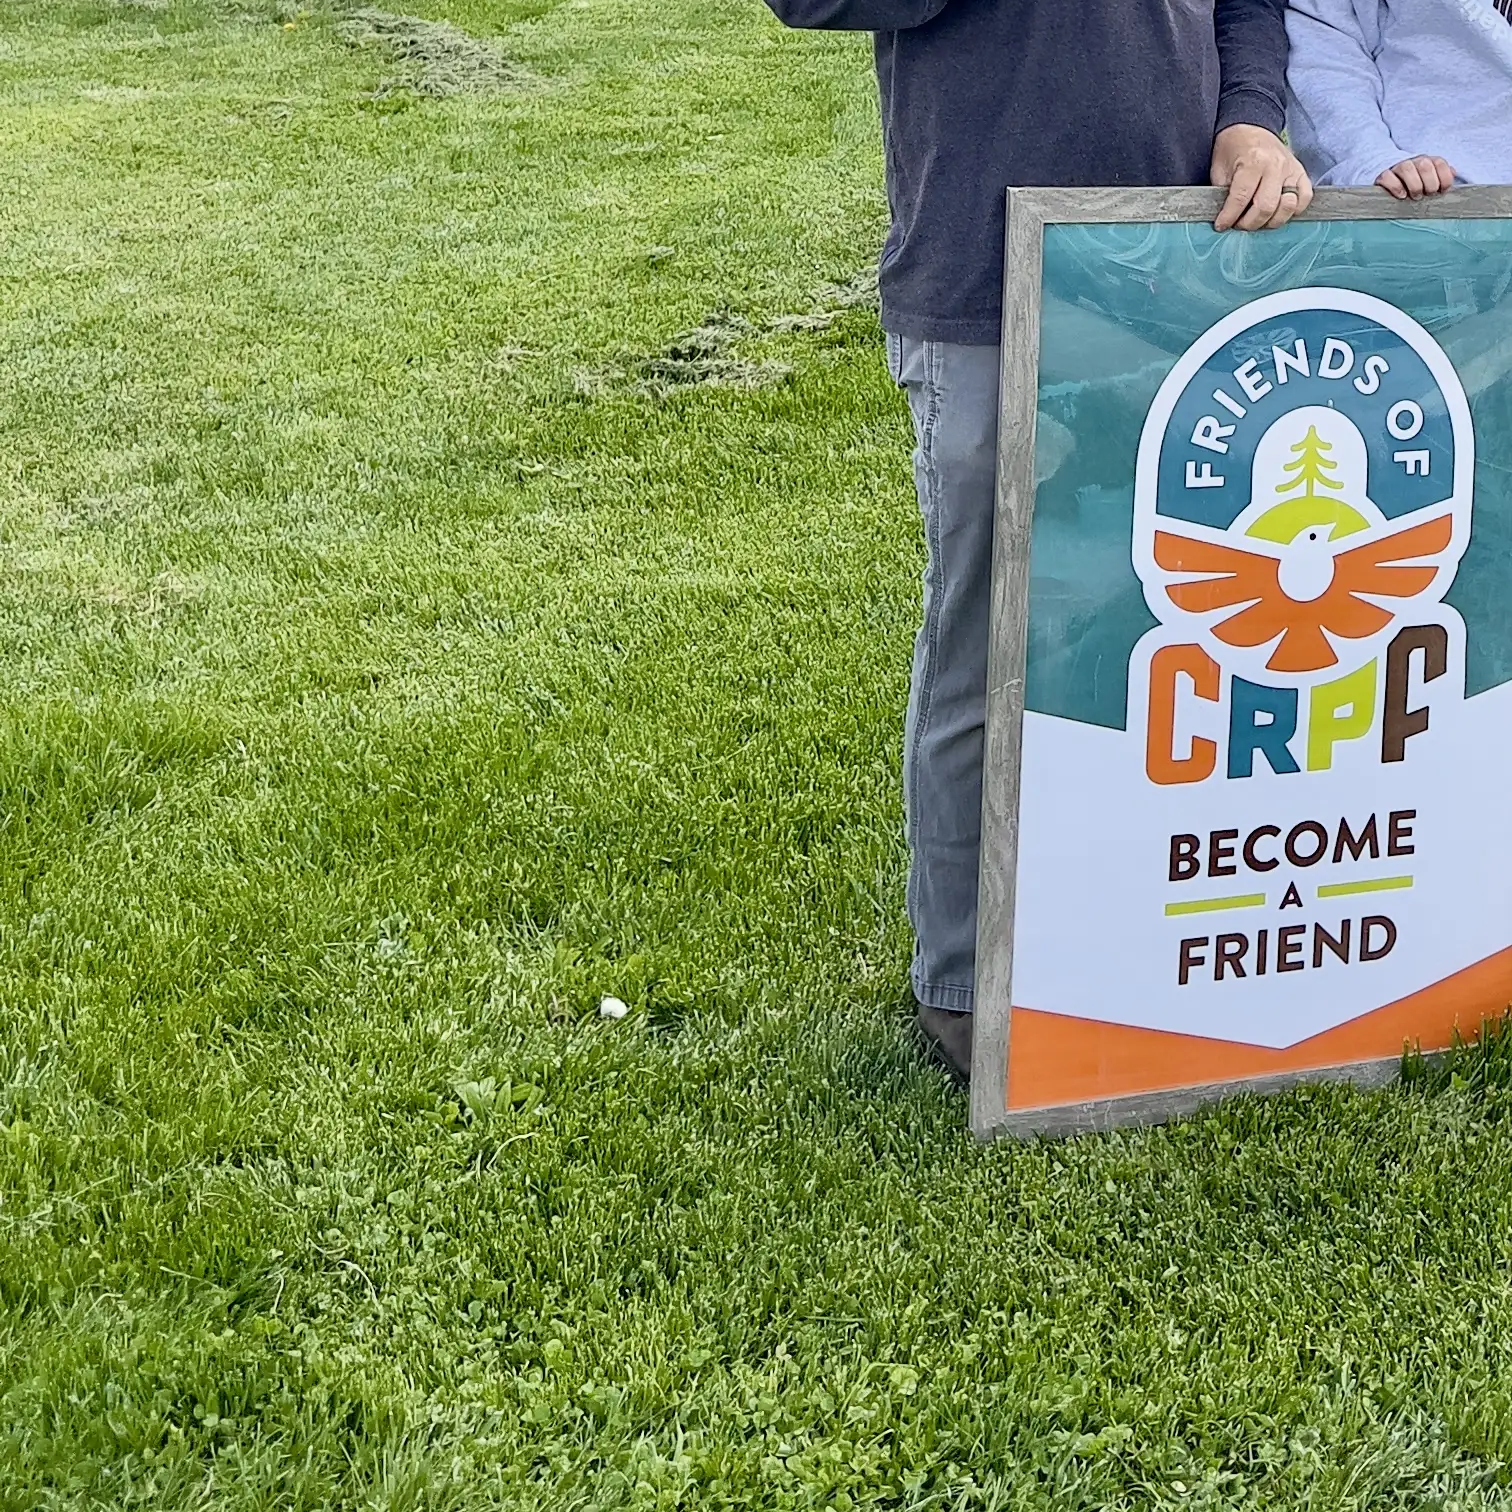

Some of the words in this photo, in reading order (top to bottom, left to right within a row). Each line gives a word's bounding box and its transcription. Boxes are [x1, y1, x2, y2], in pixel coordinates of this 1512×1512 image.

[1185, 337, 1390, 489] FRIENDS
[1386, 399, 1431, 477] OF
[1146, 624, 1448, 785] CRPF
[1168, 809, 1417, 882] BECOME
[1278, 880, 1304, 910] A
[1178, 915, 1397, 986] FRIEND
